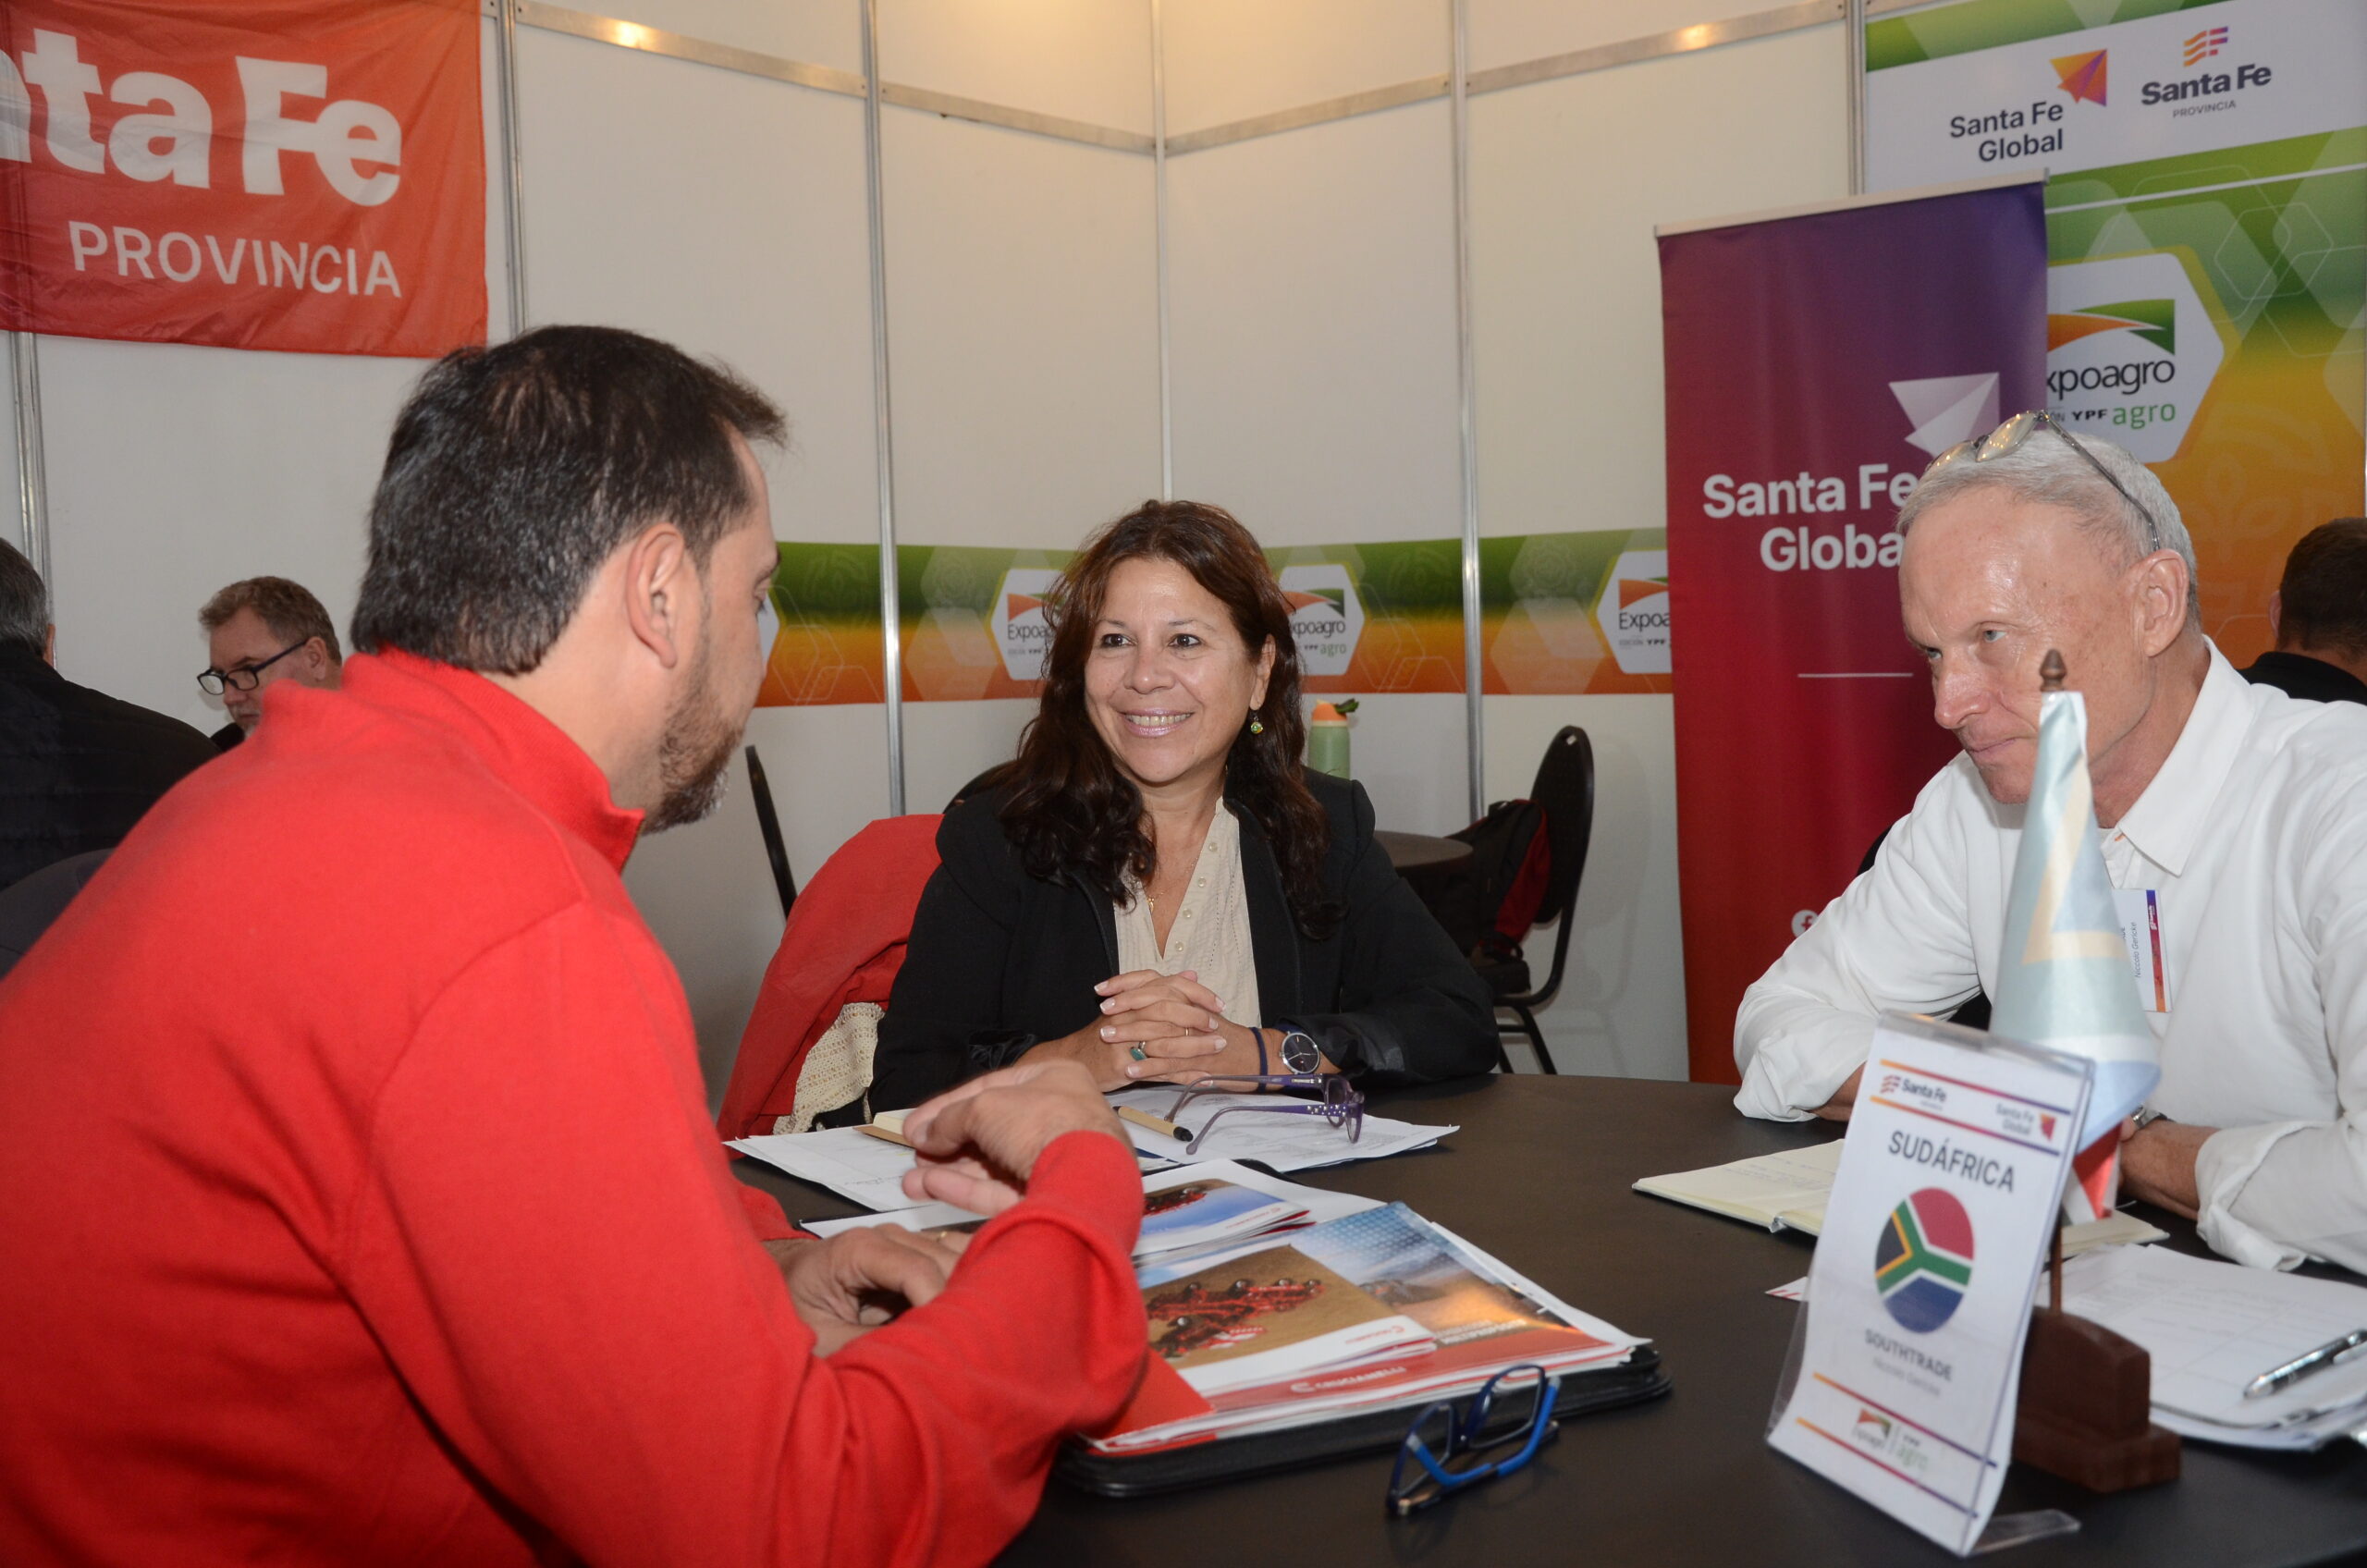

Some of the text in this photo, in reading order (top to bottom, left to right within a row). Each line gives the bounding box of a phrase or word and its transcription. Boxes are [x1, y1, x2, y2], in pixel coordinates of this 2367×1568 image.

[2141, 63, 2272, 105] Santa Fe
[1950, 101, 2063, 138] Santa Fe
[2173, 100, 2236, 117] PROVINCIA
[235, 55, 401, 206] Fe
[1979, 129, 2063, 163] Global
[69, 220, 401, 298] PROVINCIA
[2046, 360, 2176, 400] xpoagro
[2071, 409, 2108, 421] YPF
[2113, 403, 2176, 429] agro
[1703, 463, 1919, 519] Santa Fe
[1760, 524, 1905, 571] Globa
[1619, 611, 1670, 632] Expoa
[1901, 1079, 1946, 1103] Santa Fe
[1888, 1130, 2015, 1193] SUDÁFRICA
[1865, 1329, 1952, 1381] SOUTHTRADE
